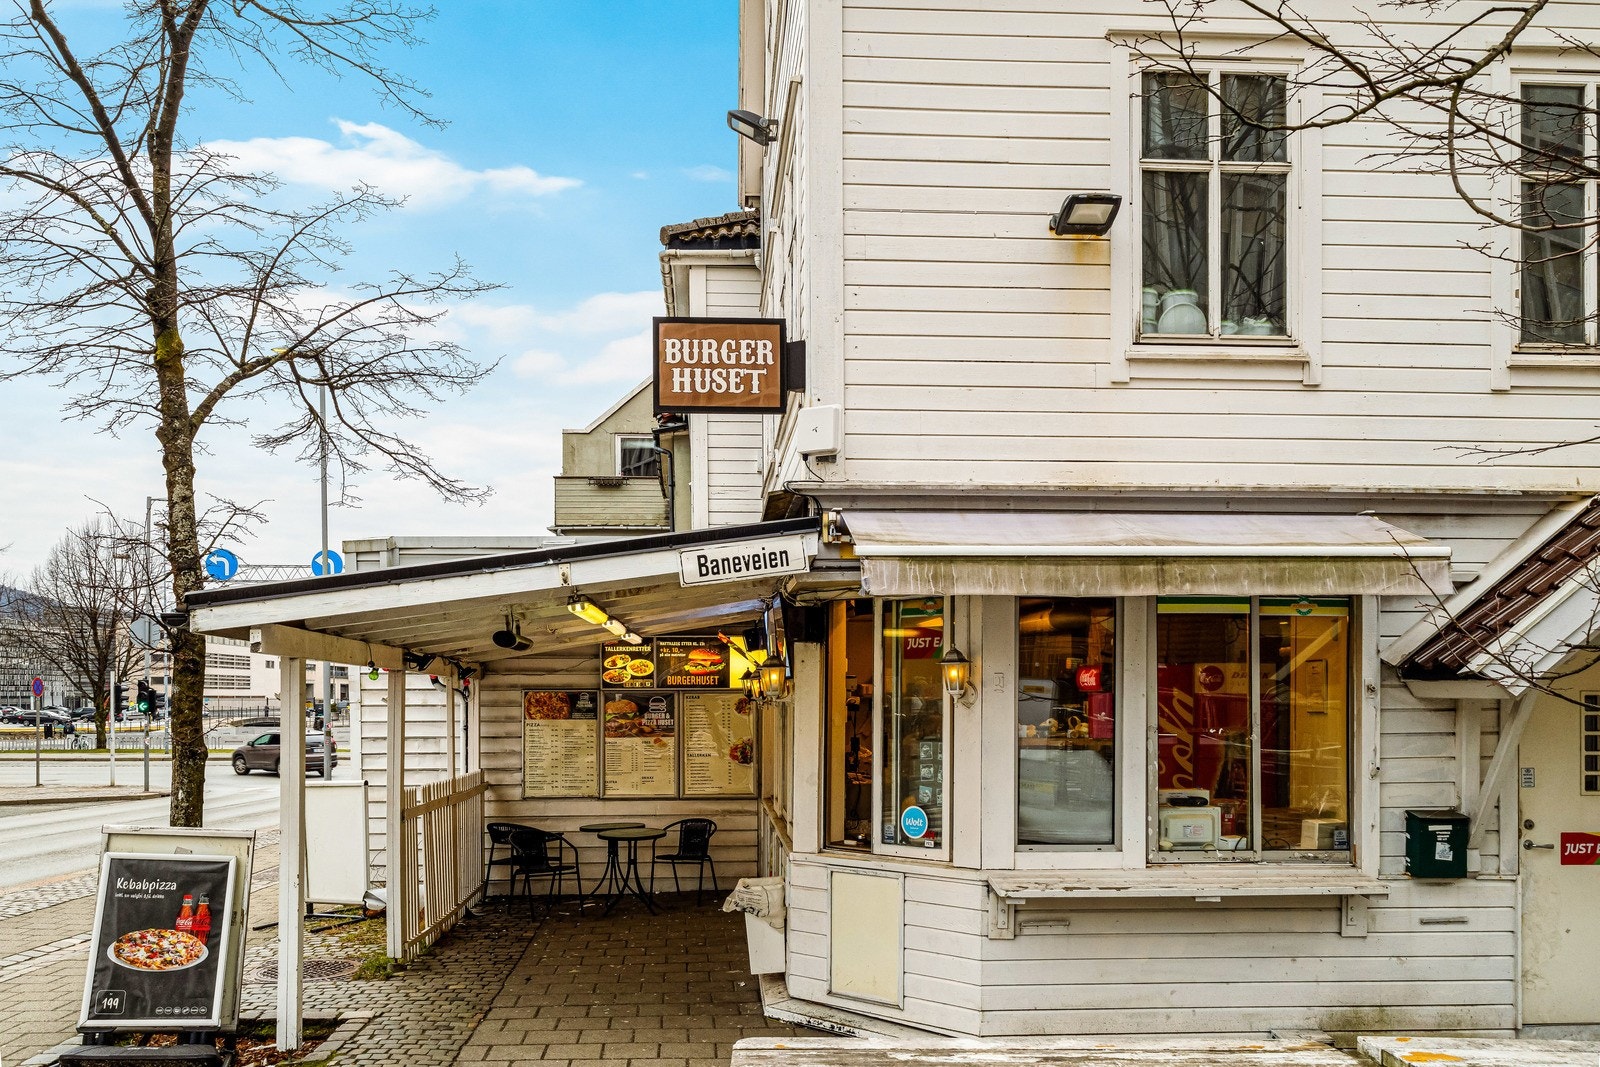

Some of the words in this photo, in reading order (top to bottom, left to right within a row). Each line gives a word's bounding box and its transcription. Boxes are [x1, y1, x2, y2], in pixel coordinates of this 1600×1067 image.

[663, 338, 774, 365] BURGER
[671, 367, 767, 394] HUSET
[697, 547, 789, 577] Baneveien
[907, 637, 931, 649] JUST
[667, 676, 719, 685] BURGERHUSET
[905, 817, 924, 827] Wolt
[1564, 843, 1594, 855] JUST
[116, 878, 176, 893] Kebabpizza
[102, 998, 119, 1009] 199
